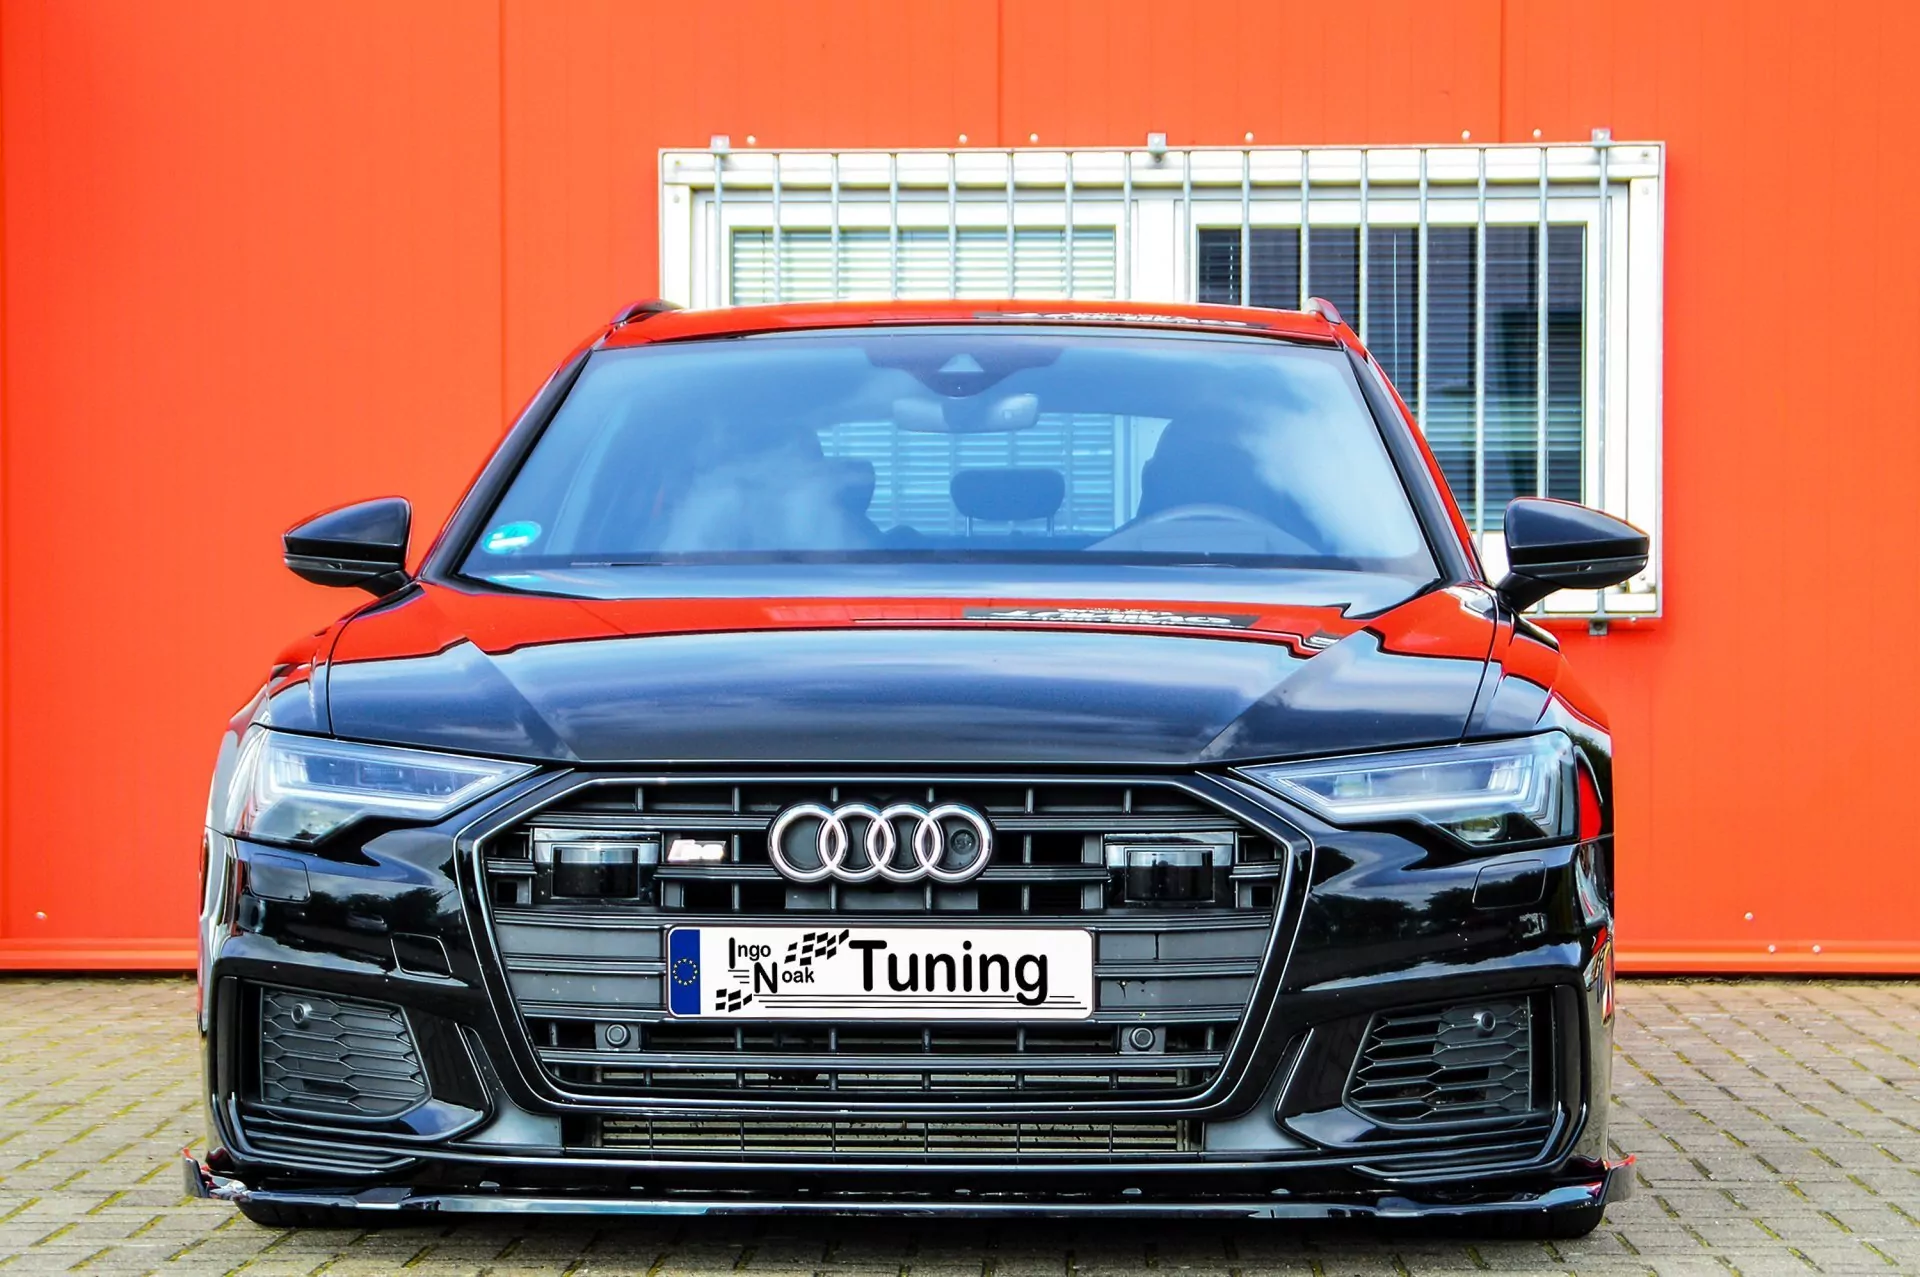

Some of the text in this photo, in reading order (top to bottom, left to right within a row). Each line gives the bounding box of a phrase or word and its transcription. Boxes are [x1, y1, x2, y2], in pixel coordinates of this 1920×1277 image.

[729, 937, 771, 969] Ingo
[754, 962, 815, 994] Noak
[848, 940, 1048, 1005] Tuning
